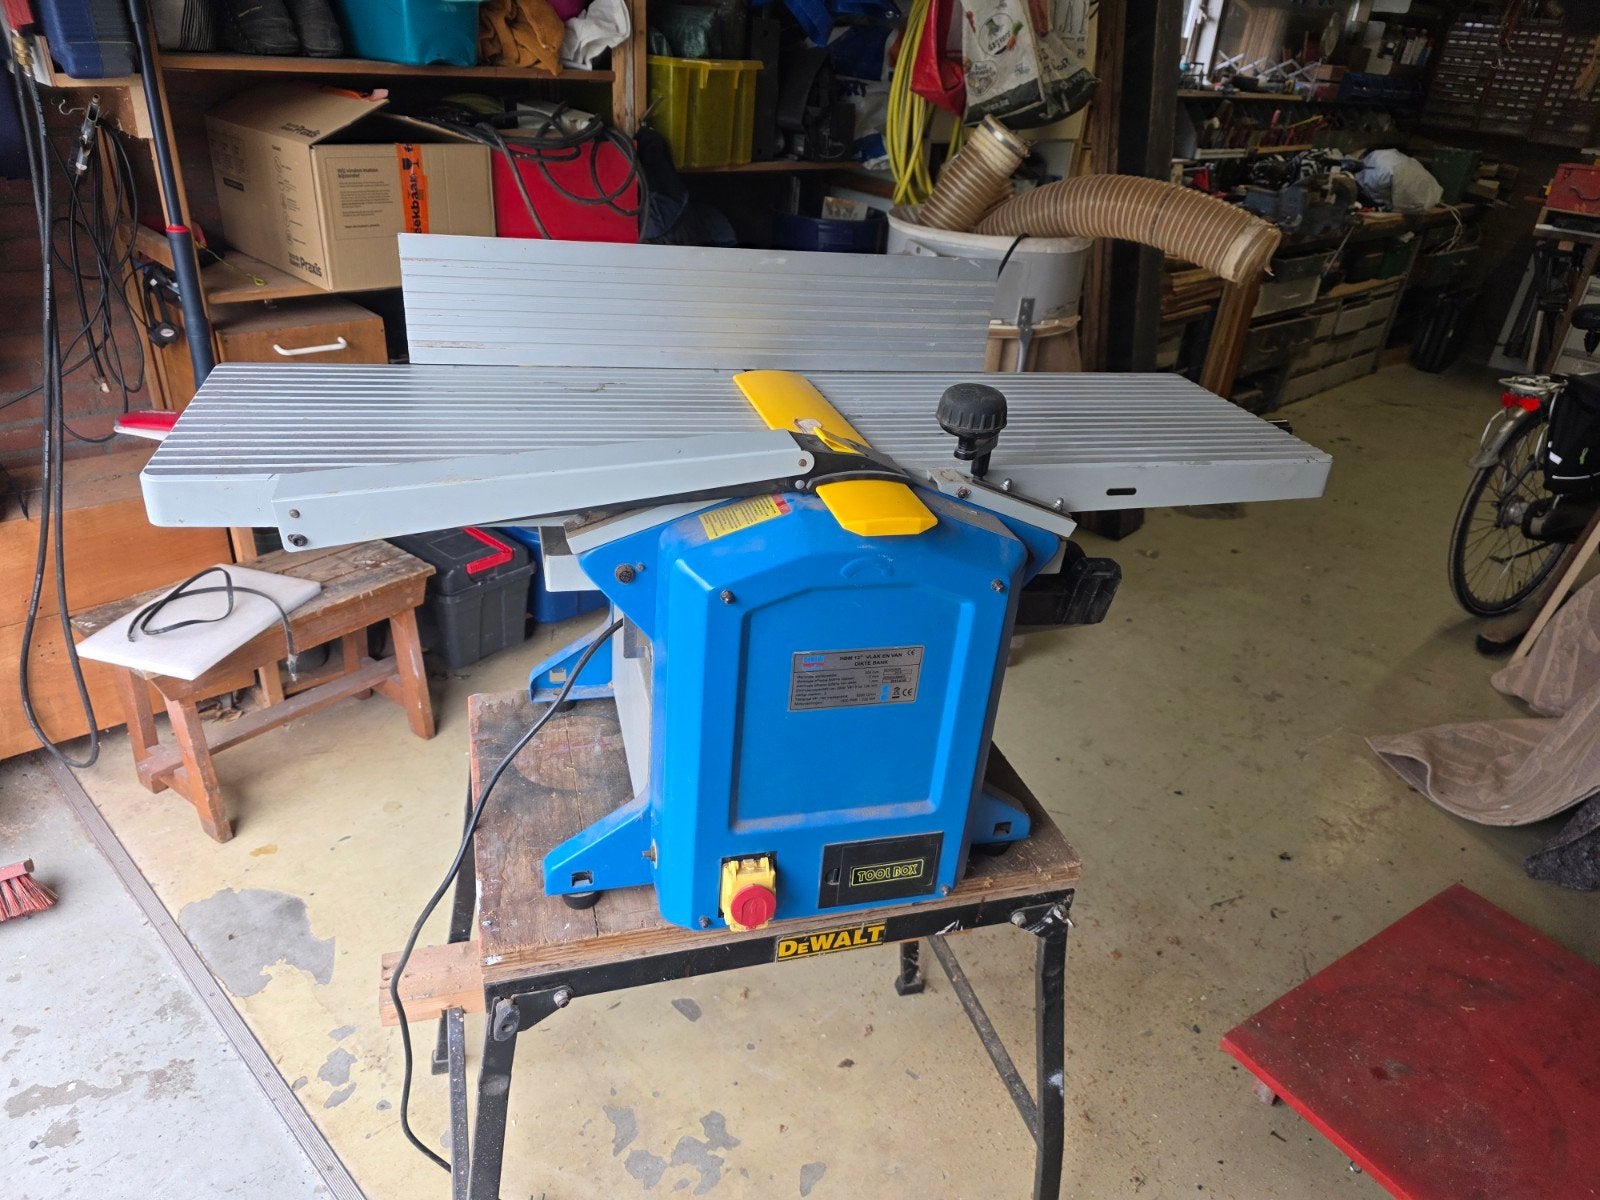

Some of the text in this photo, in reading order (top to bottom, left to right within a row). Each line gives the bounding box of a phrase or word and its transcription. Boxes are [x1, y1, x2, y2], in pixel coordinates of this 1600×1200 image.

[410, 175, 422, 233] eekbaar
[300, 256, 322, 277] Praxis
[857, 863, 918, 882] TOOL BOX
